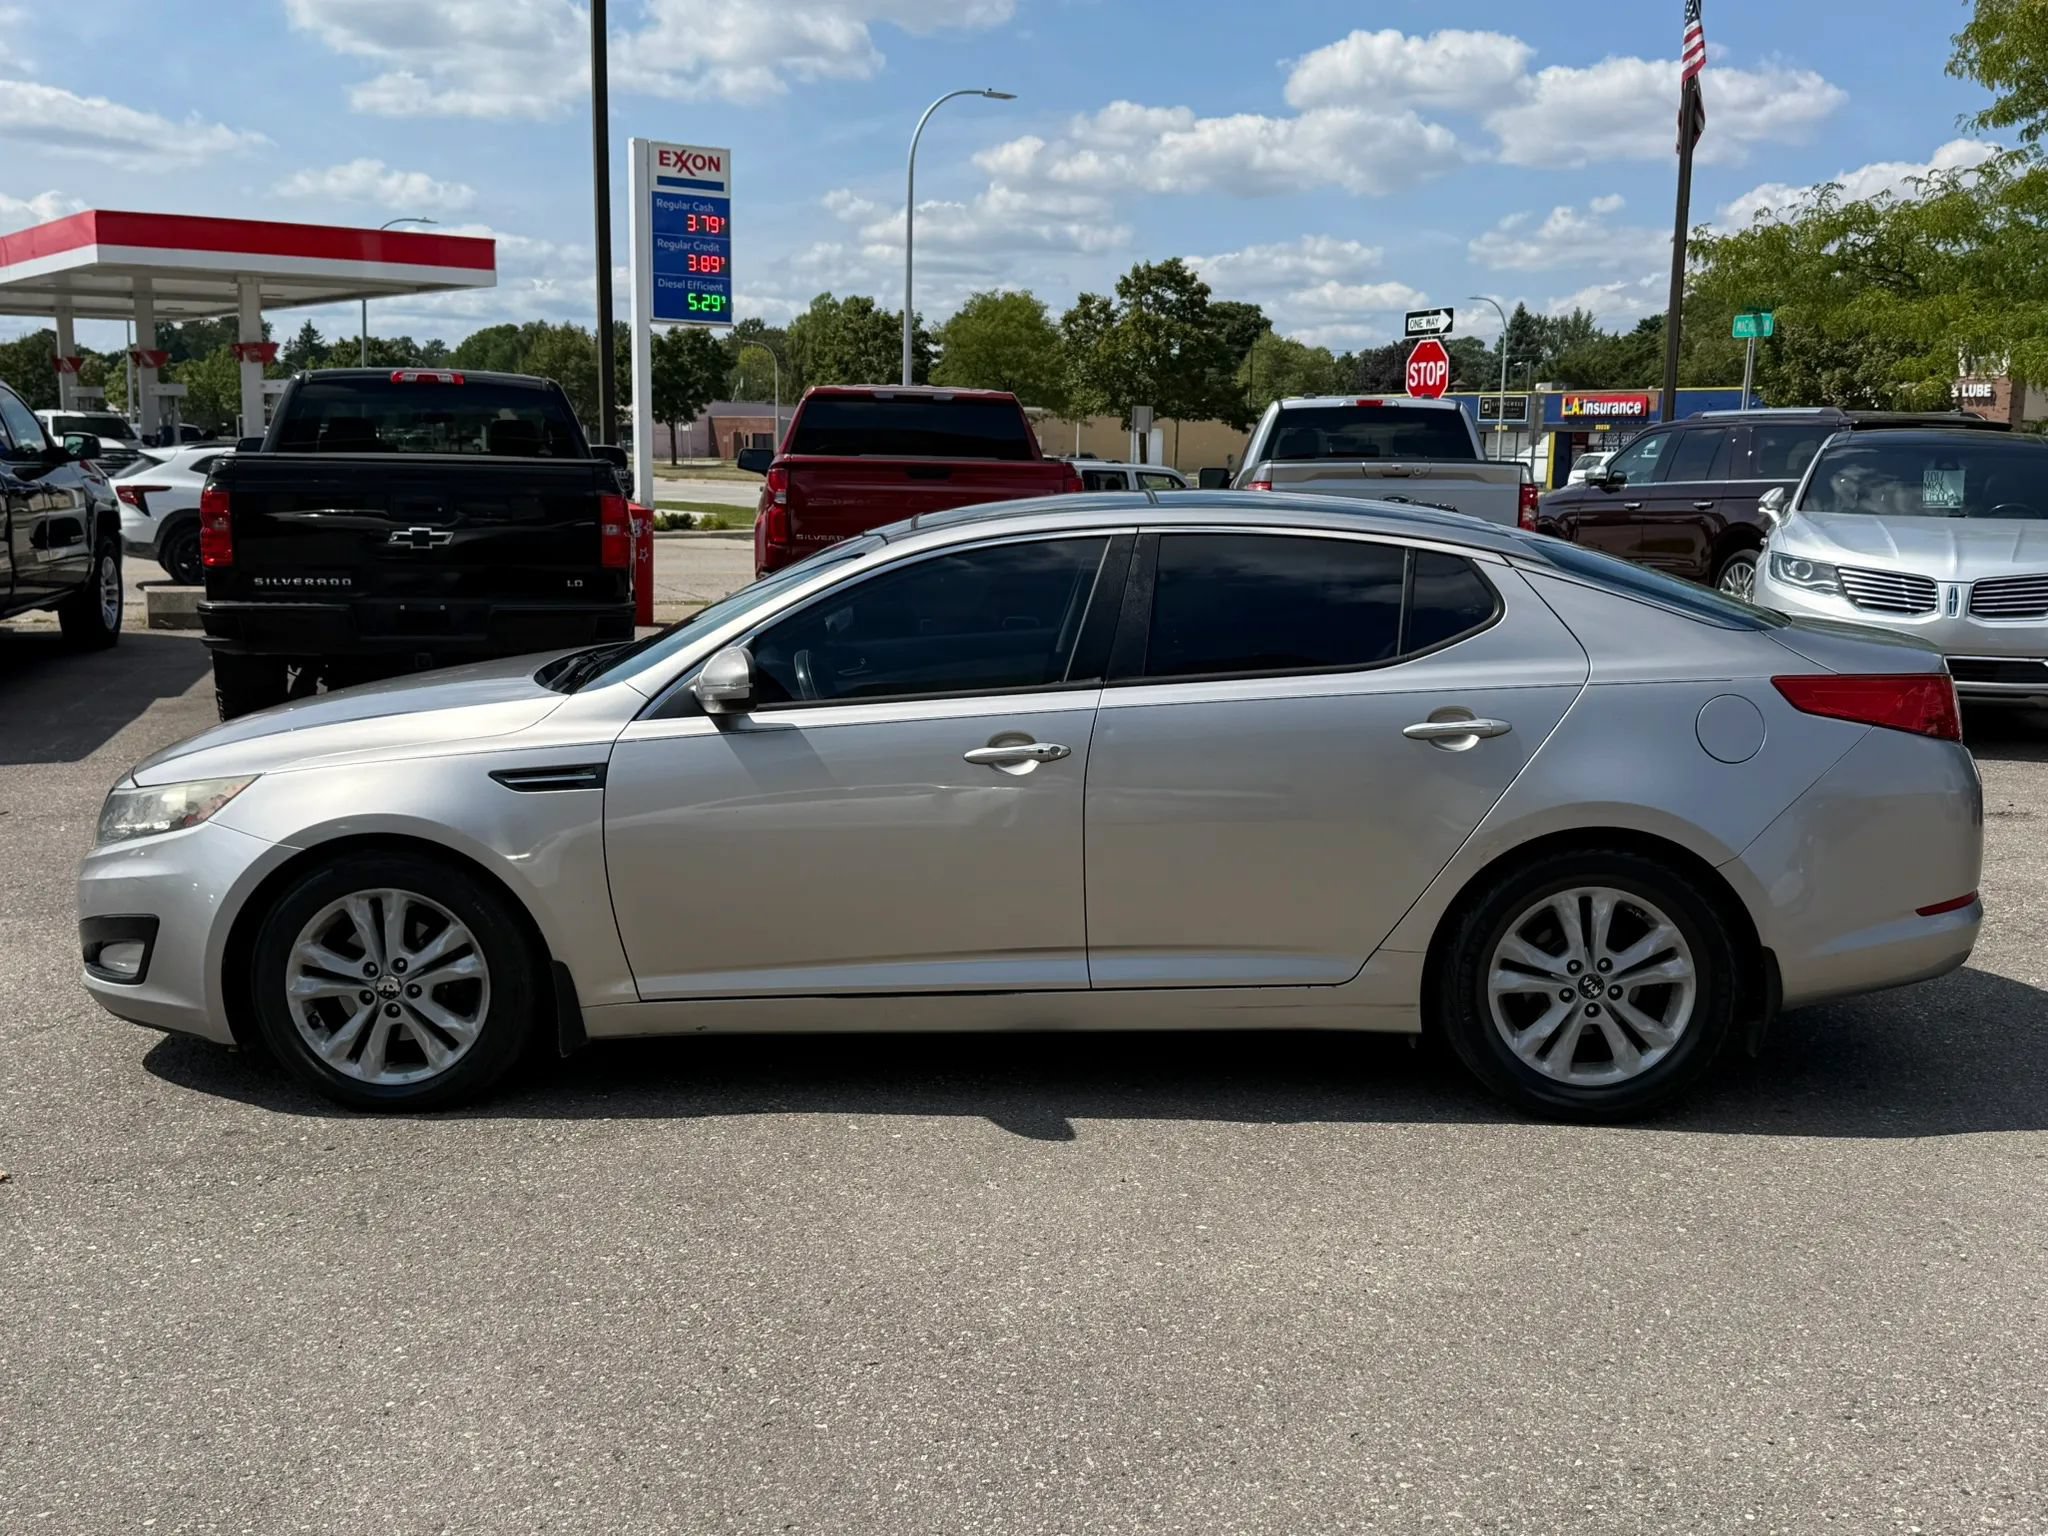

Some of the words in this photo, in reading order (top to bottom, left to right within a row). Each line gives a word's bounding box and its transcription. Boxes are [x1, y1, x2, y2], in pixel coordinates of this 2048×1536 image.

[658, 149, 721, 177] EXXON
[656, 198, 691, 212] Regular
[692, 201, 714, 213] Cash
[657, 238, 692, 251] Regular
[693, 240, 720, 252] Credit
[657, 278, 686, 290] Diesel
[687, 280, 724, 292] Efficient
[1409, 318, 1424, 330] ONE
[1425, 316, 1440, 328] WAY
[1409, 360, 1446, 387] STOP
[1961, 383, 1992, 398] LUBE
[254, 577, 352, 586] SILVERADO
